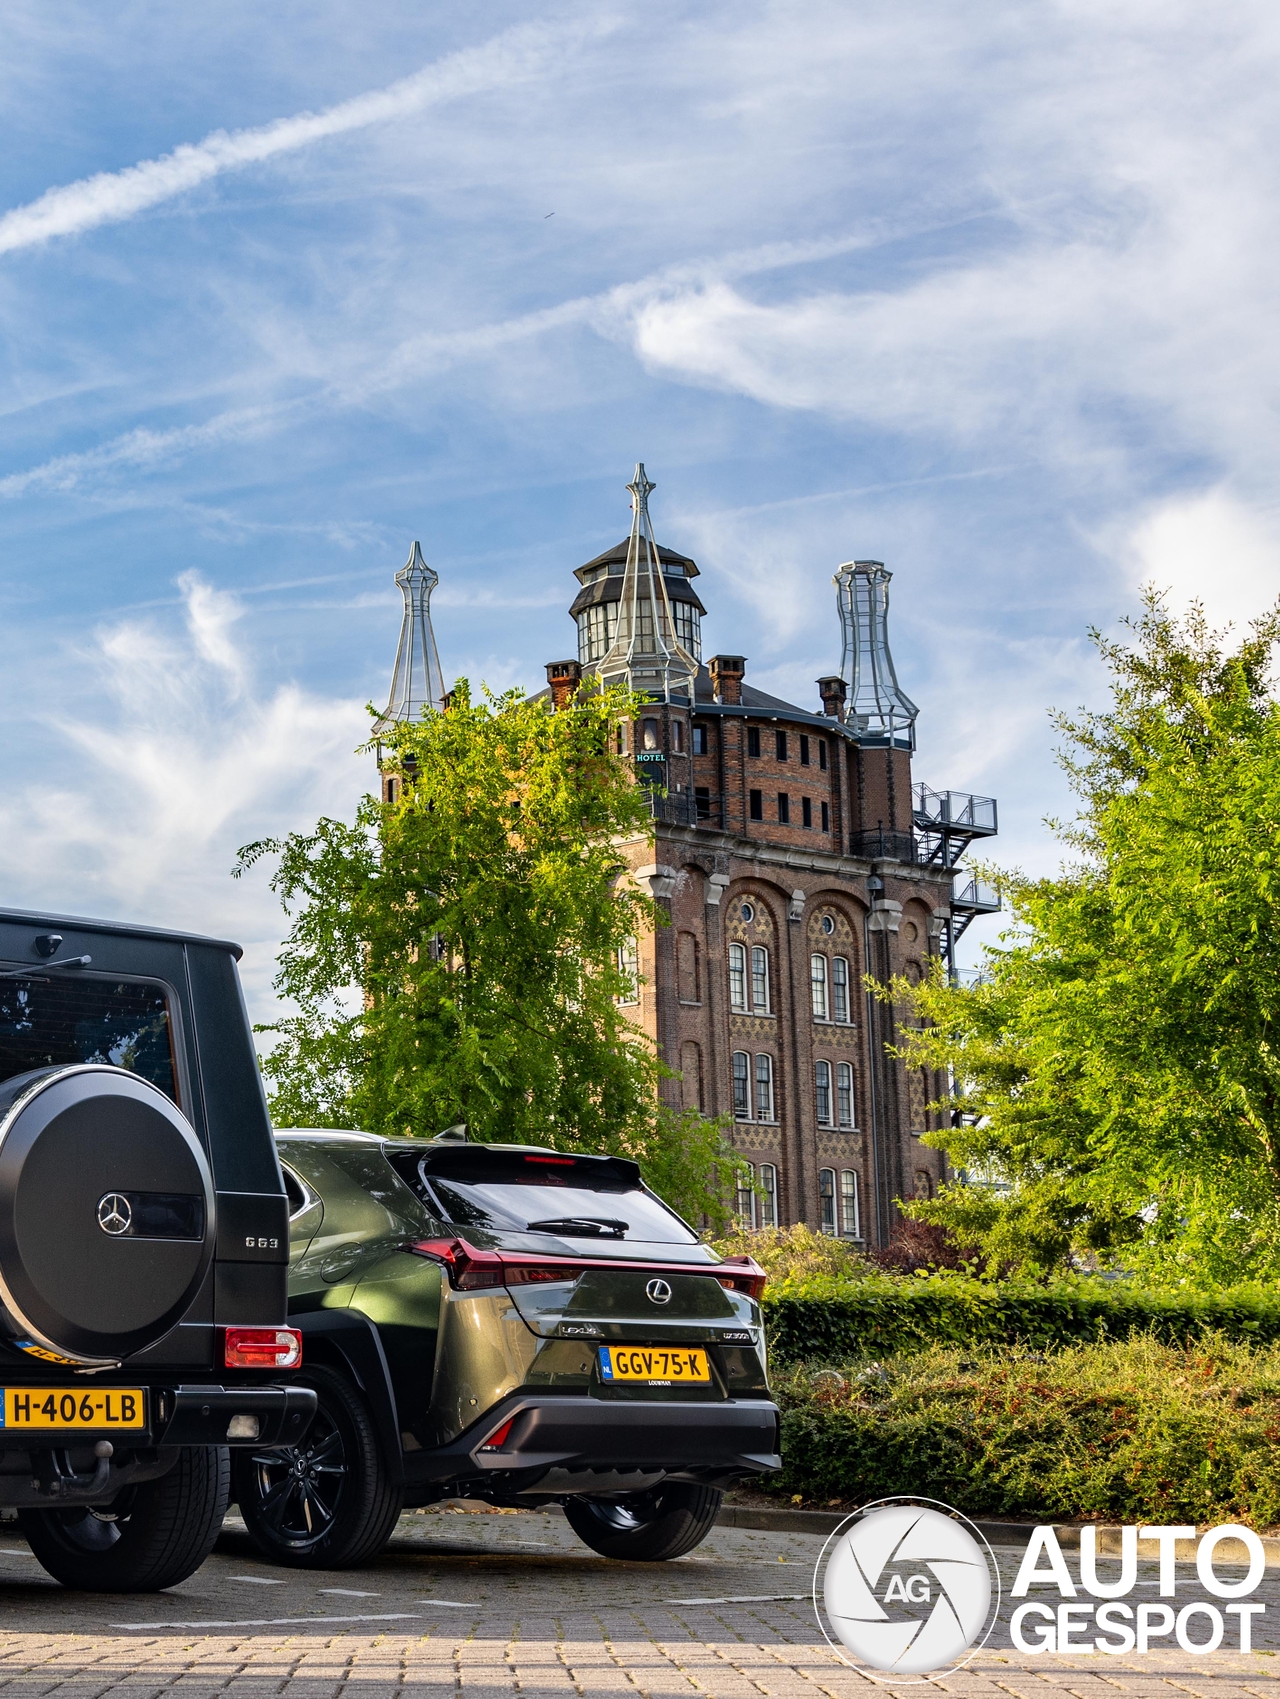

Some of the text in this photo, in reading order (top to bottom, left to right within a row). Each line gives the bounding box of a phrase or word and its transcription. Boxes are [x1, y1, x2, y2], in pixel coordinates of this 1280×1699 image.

[637, 754, 666, 762] HOTEL
[562, 1326, 596, 1335] LEXUS
[603, 1352, 701, 1376] NL GGV-75-K
[14, 1394, 136, 1422] H-406-LB
